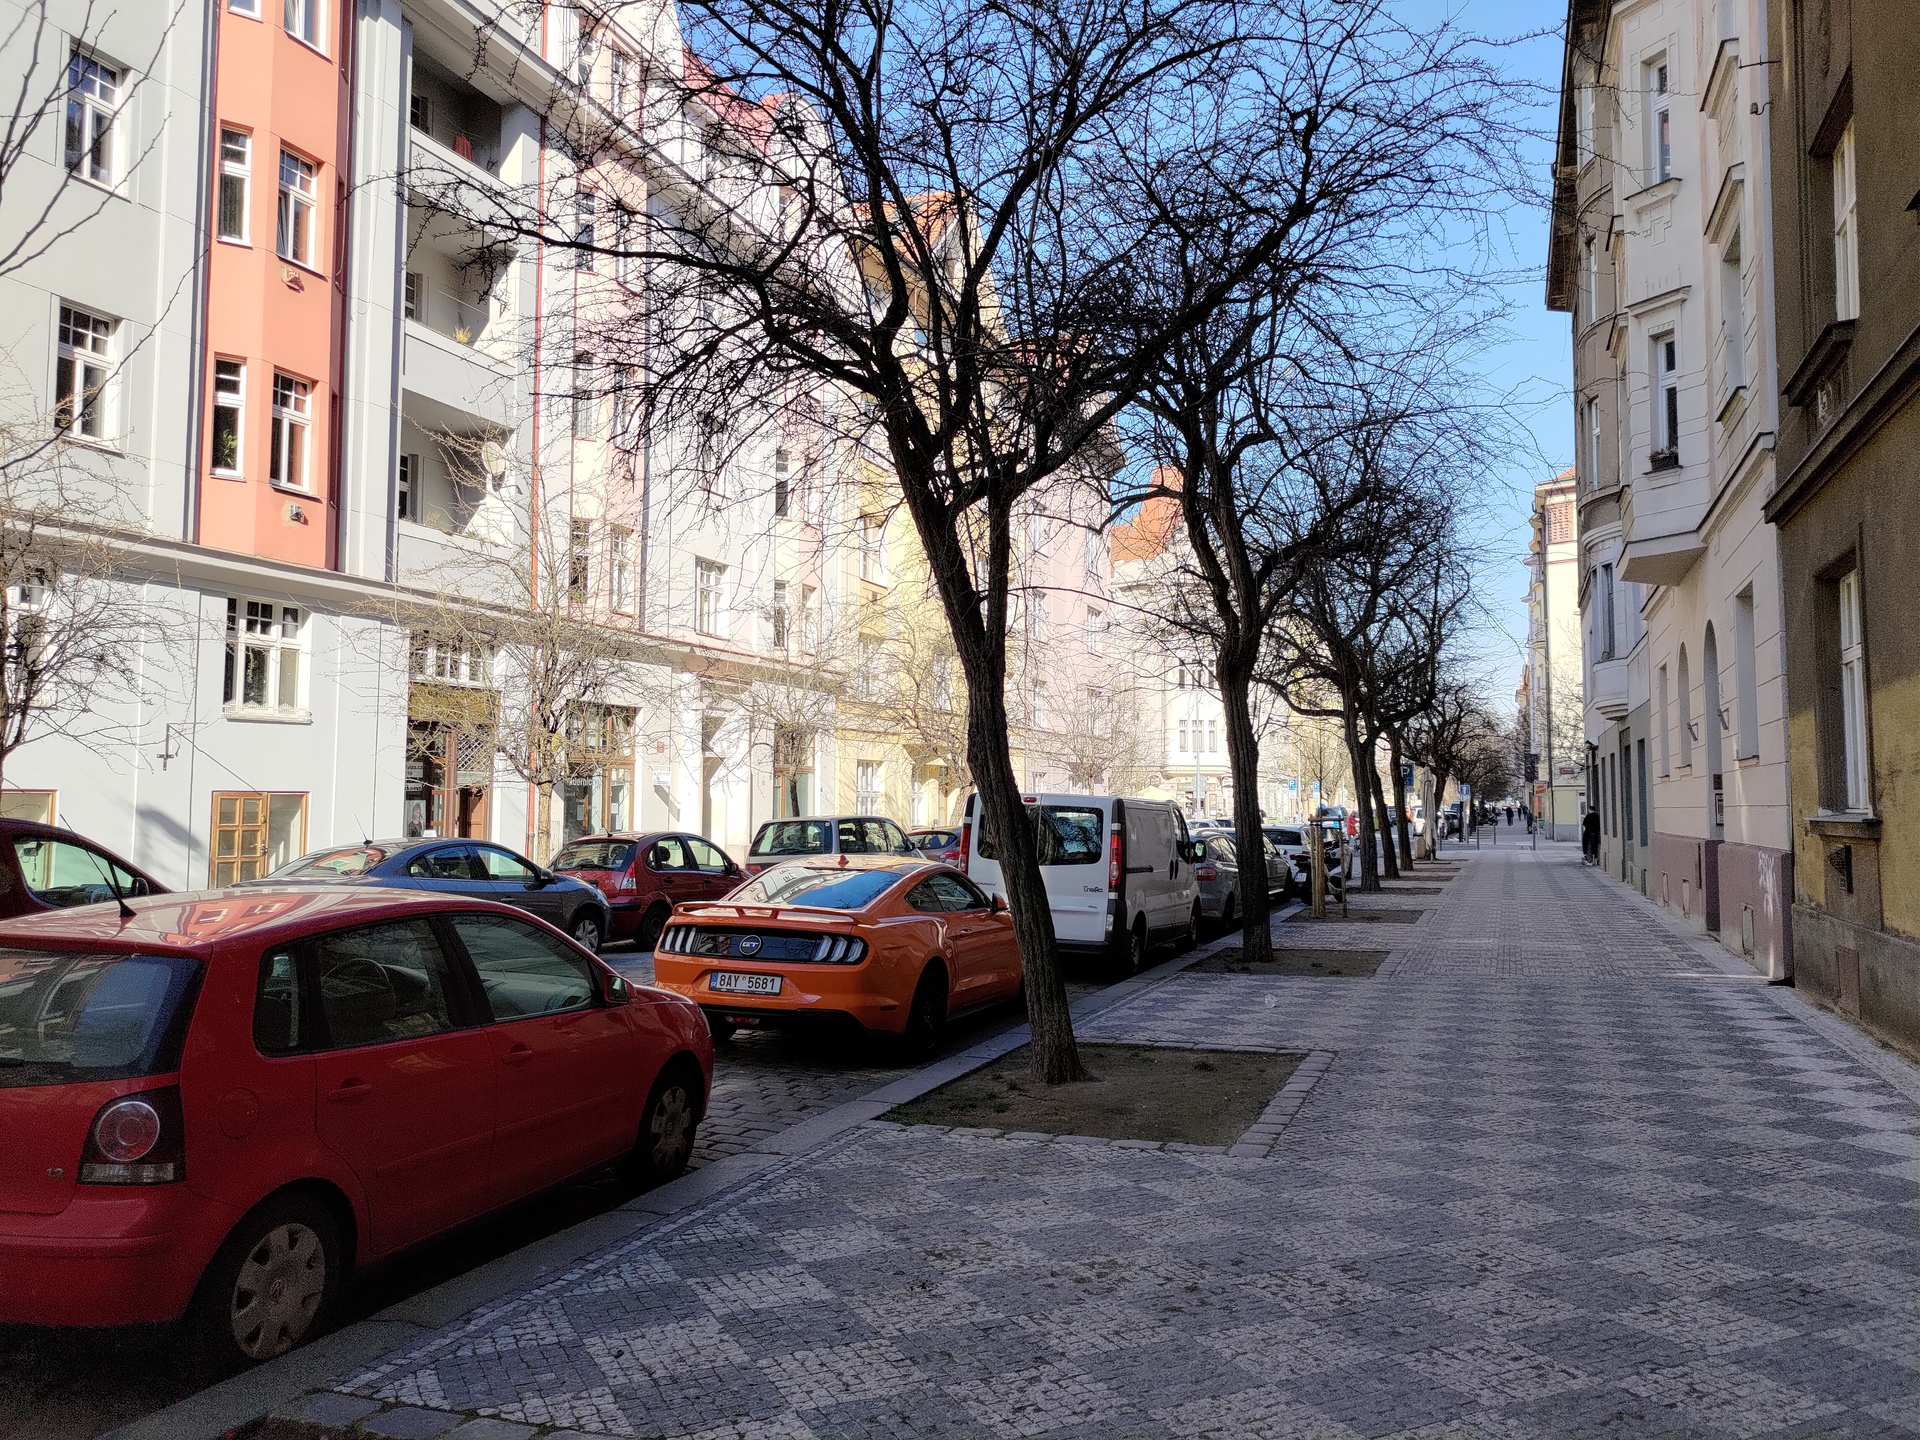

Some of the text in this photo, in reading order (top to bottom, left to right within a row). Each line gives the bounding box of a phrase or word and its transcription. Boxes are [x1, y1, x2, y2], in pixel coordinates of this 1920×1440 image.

[1081, 885, 1104, 893] Trafic
[719, 974, 776, 991] 8AY 5681
